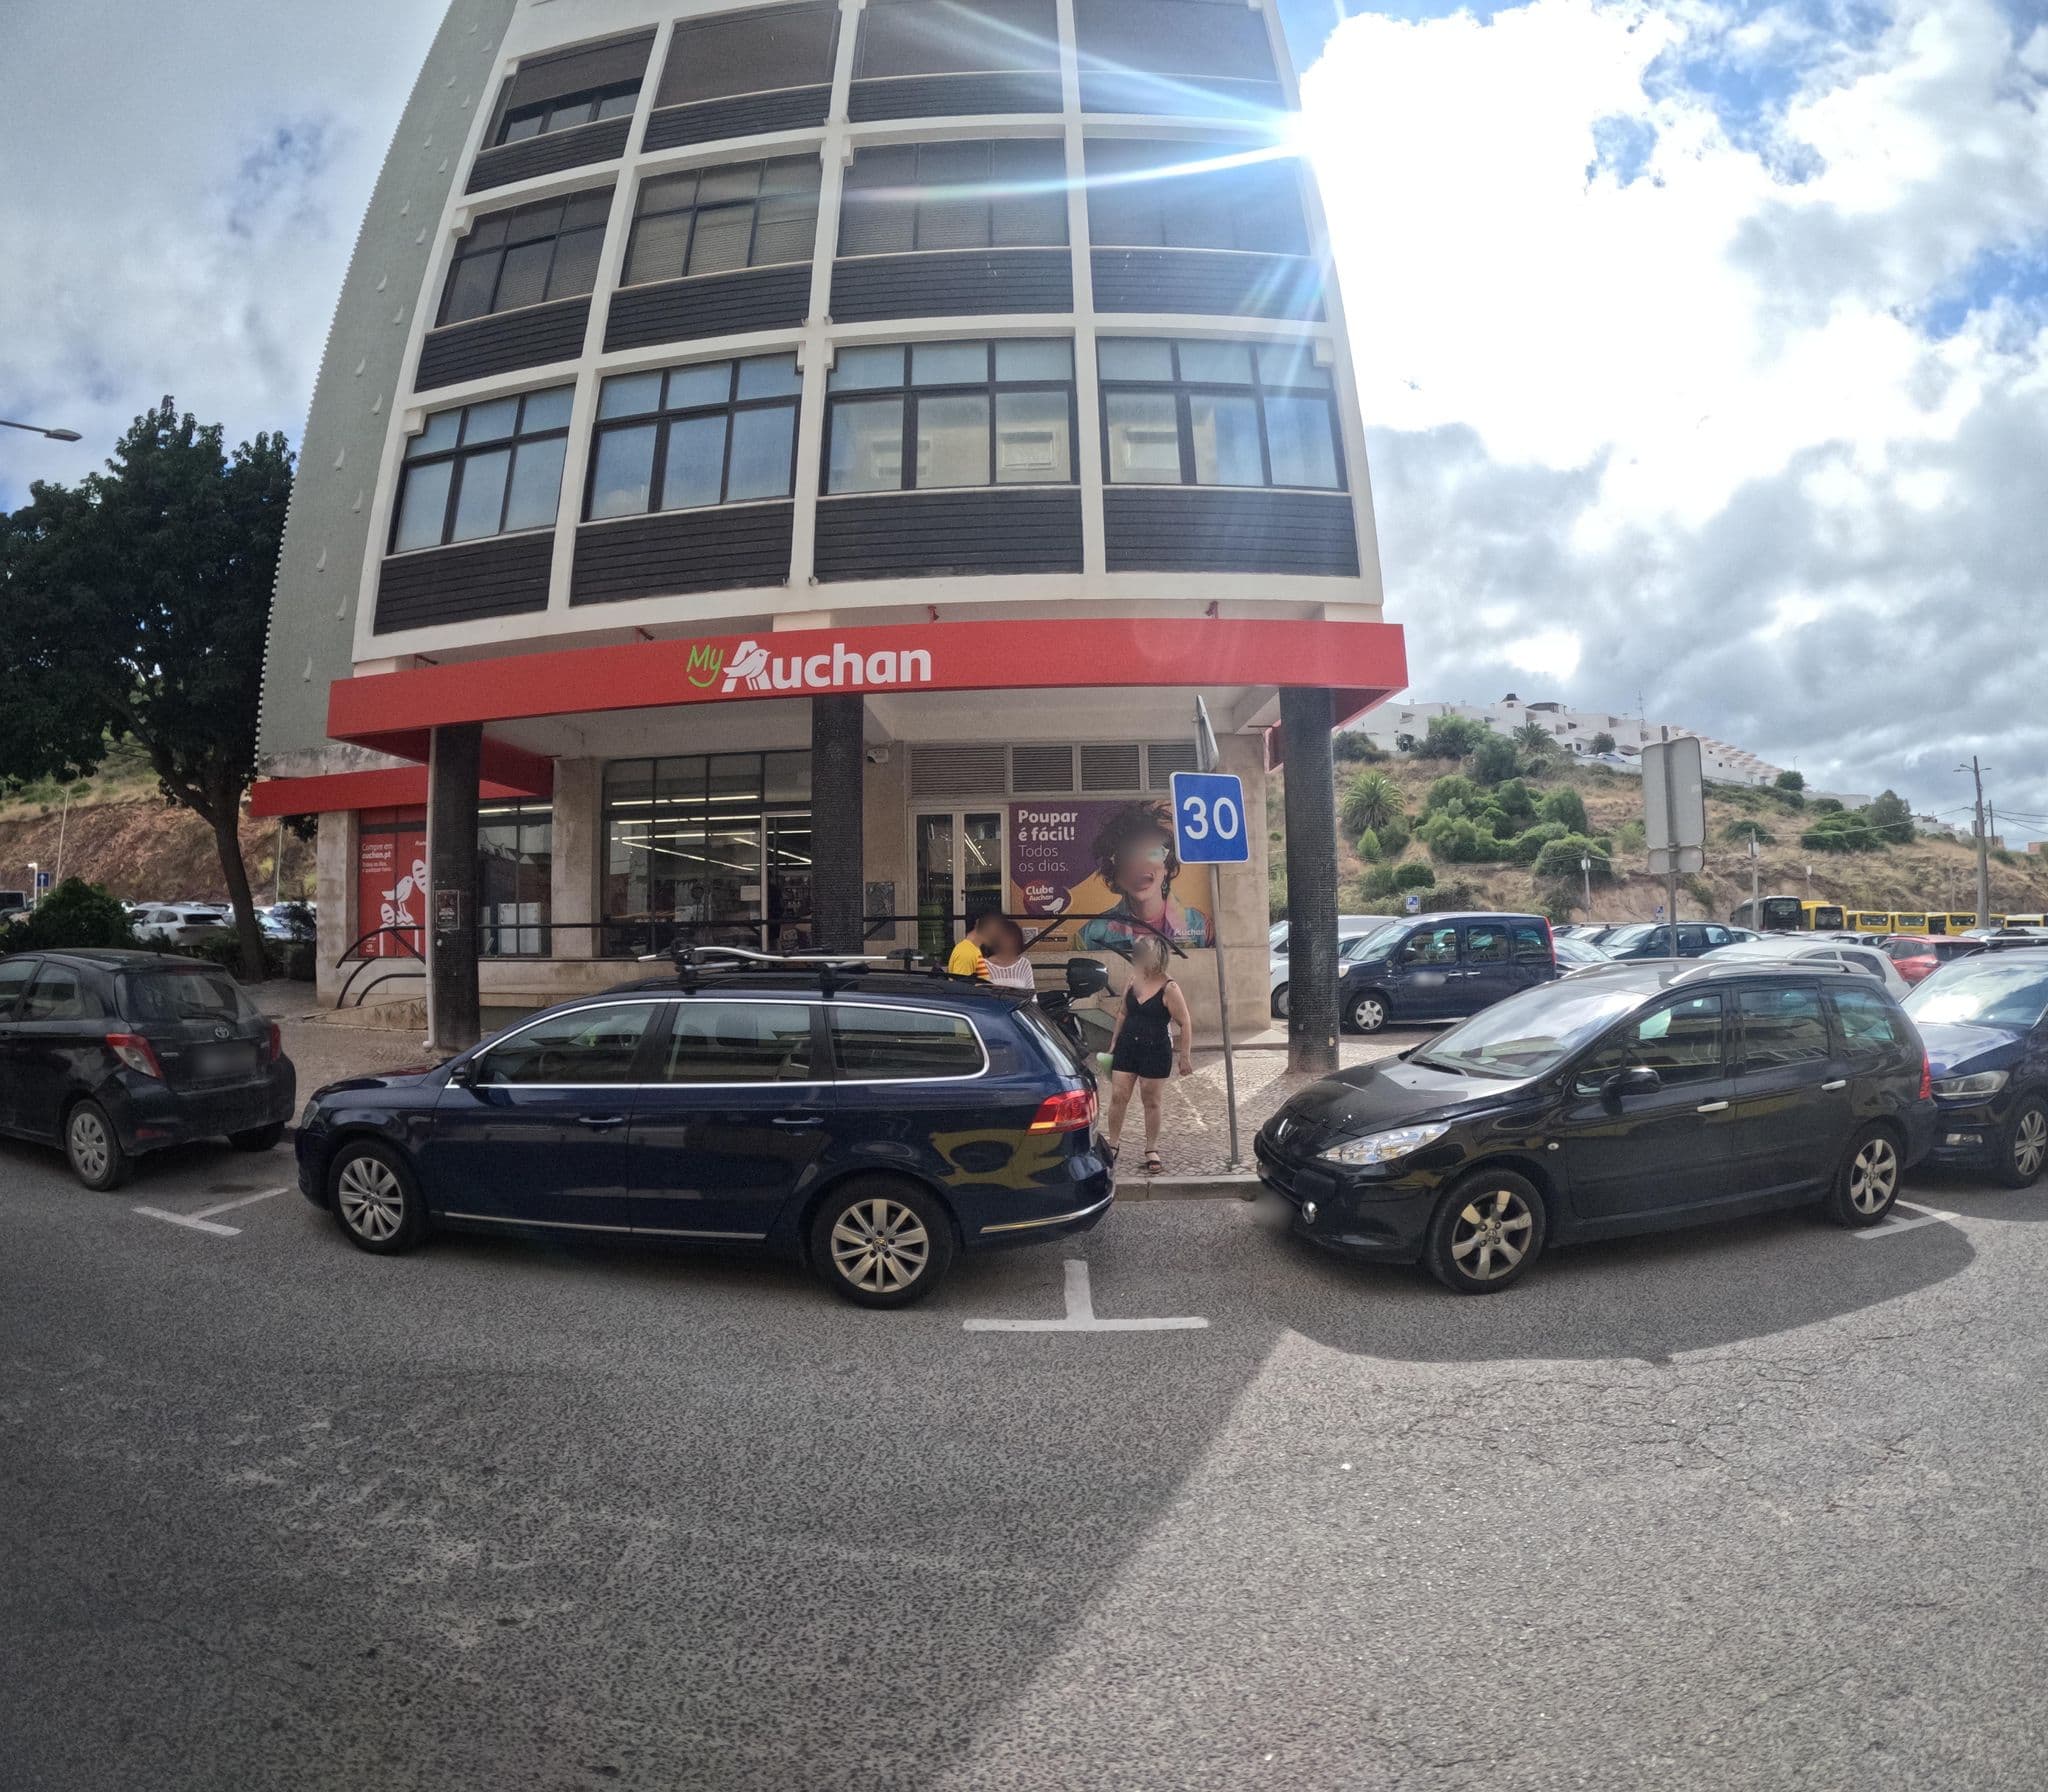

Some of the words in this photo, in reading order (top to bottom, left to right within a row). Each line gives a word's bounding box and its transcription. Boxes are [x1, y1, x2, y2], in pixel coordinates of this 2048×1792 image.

[686, 643, 725, 684] My
[721, 640, 932, 693] Auchan
[1018, 809, 1079, 827] Poupar
[1183, 795, 1240, 841] 30
[1018, 826, 1028, 842] é
[1031, 826, 1075, 842] fácil!
[1018, 844, 1059, 858] Todos
[1018, 862, 1034, 872] os
[1038, 859, 1069, 872] dias.
[1025, 885, 1055, 896] Clube
